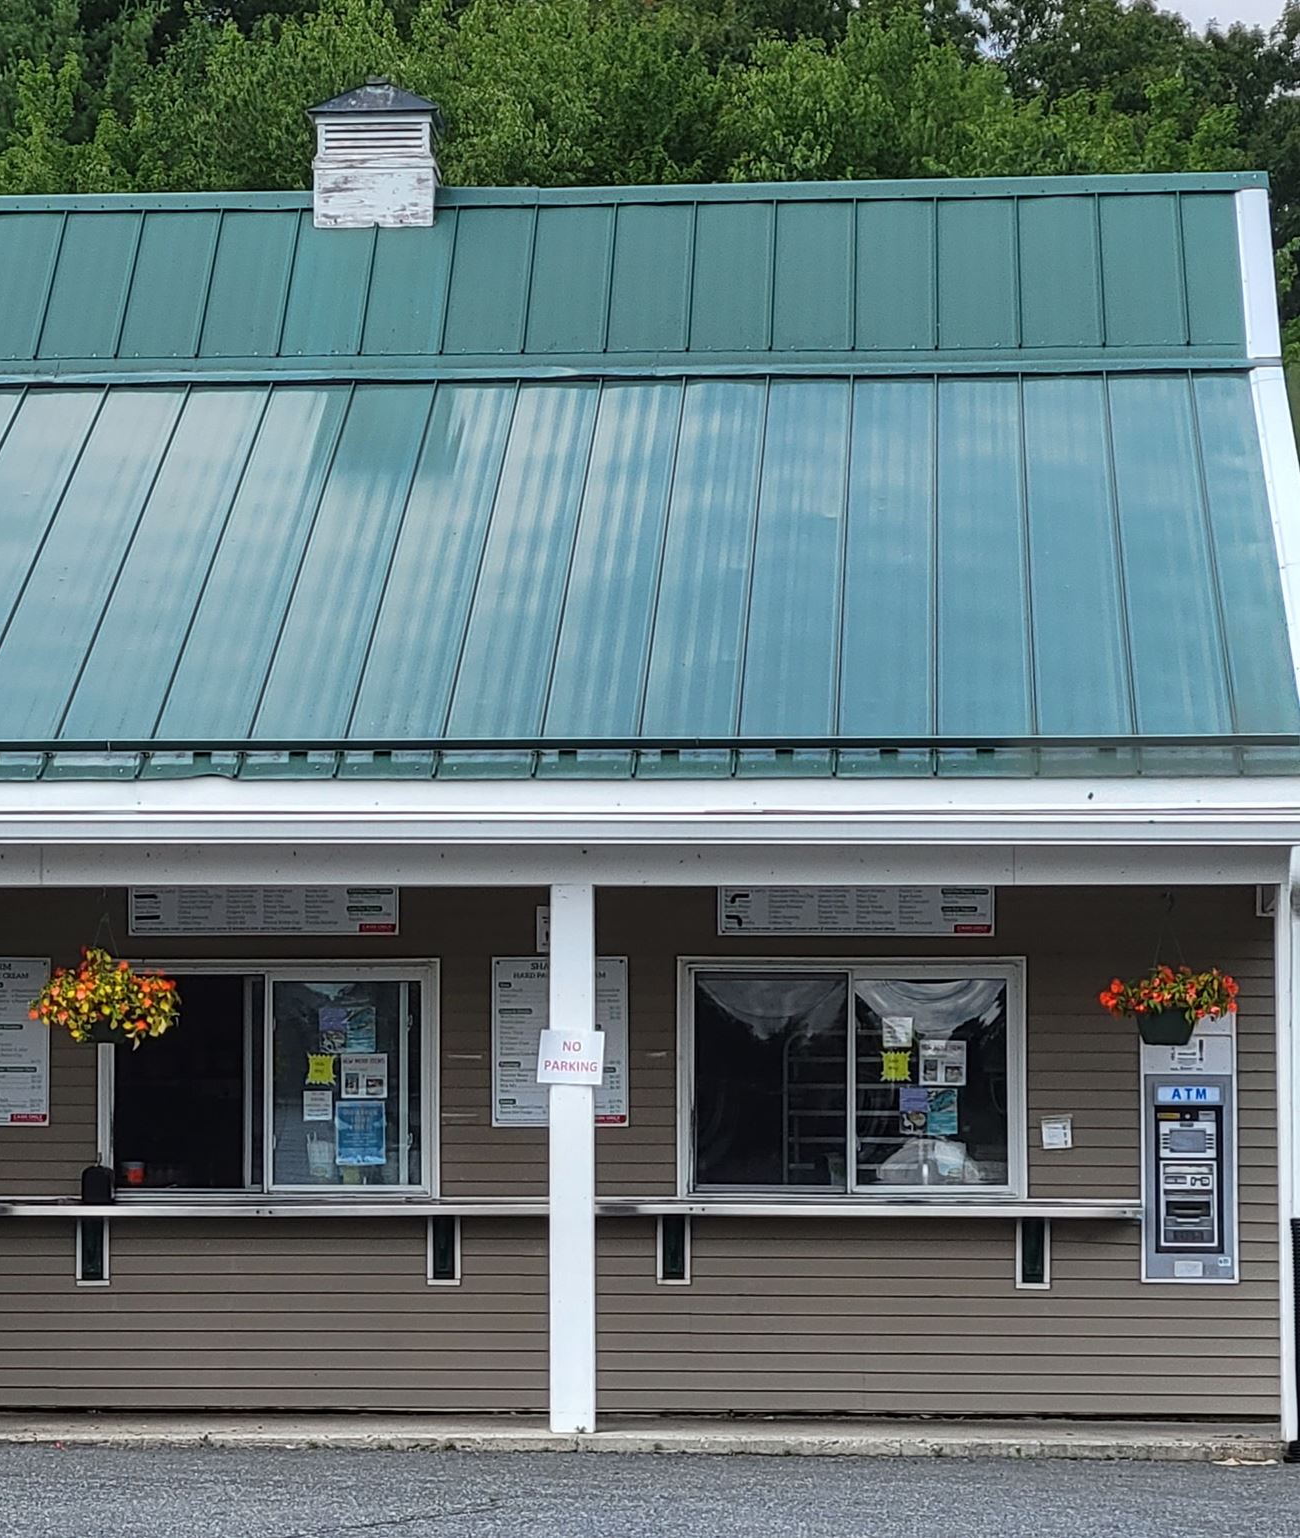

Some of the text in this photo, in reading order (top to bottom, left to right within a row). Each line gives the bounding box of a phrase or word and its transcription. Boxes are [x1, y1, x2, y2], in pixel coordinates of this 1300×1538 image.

[531, 962, 549, 970] SHA
[562, 1040, 582, 1053] NO
[544, 1060, 598, 1073] PARKING
[1171, 1087, 1207, 1100] ATM
